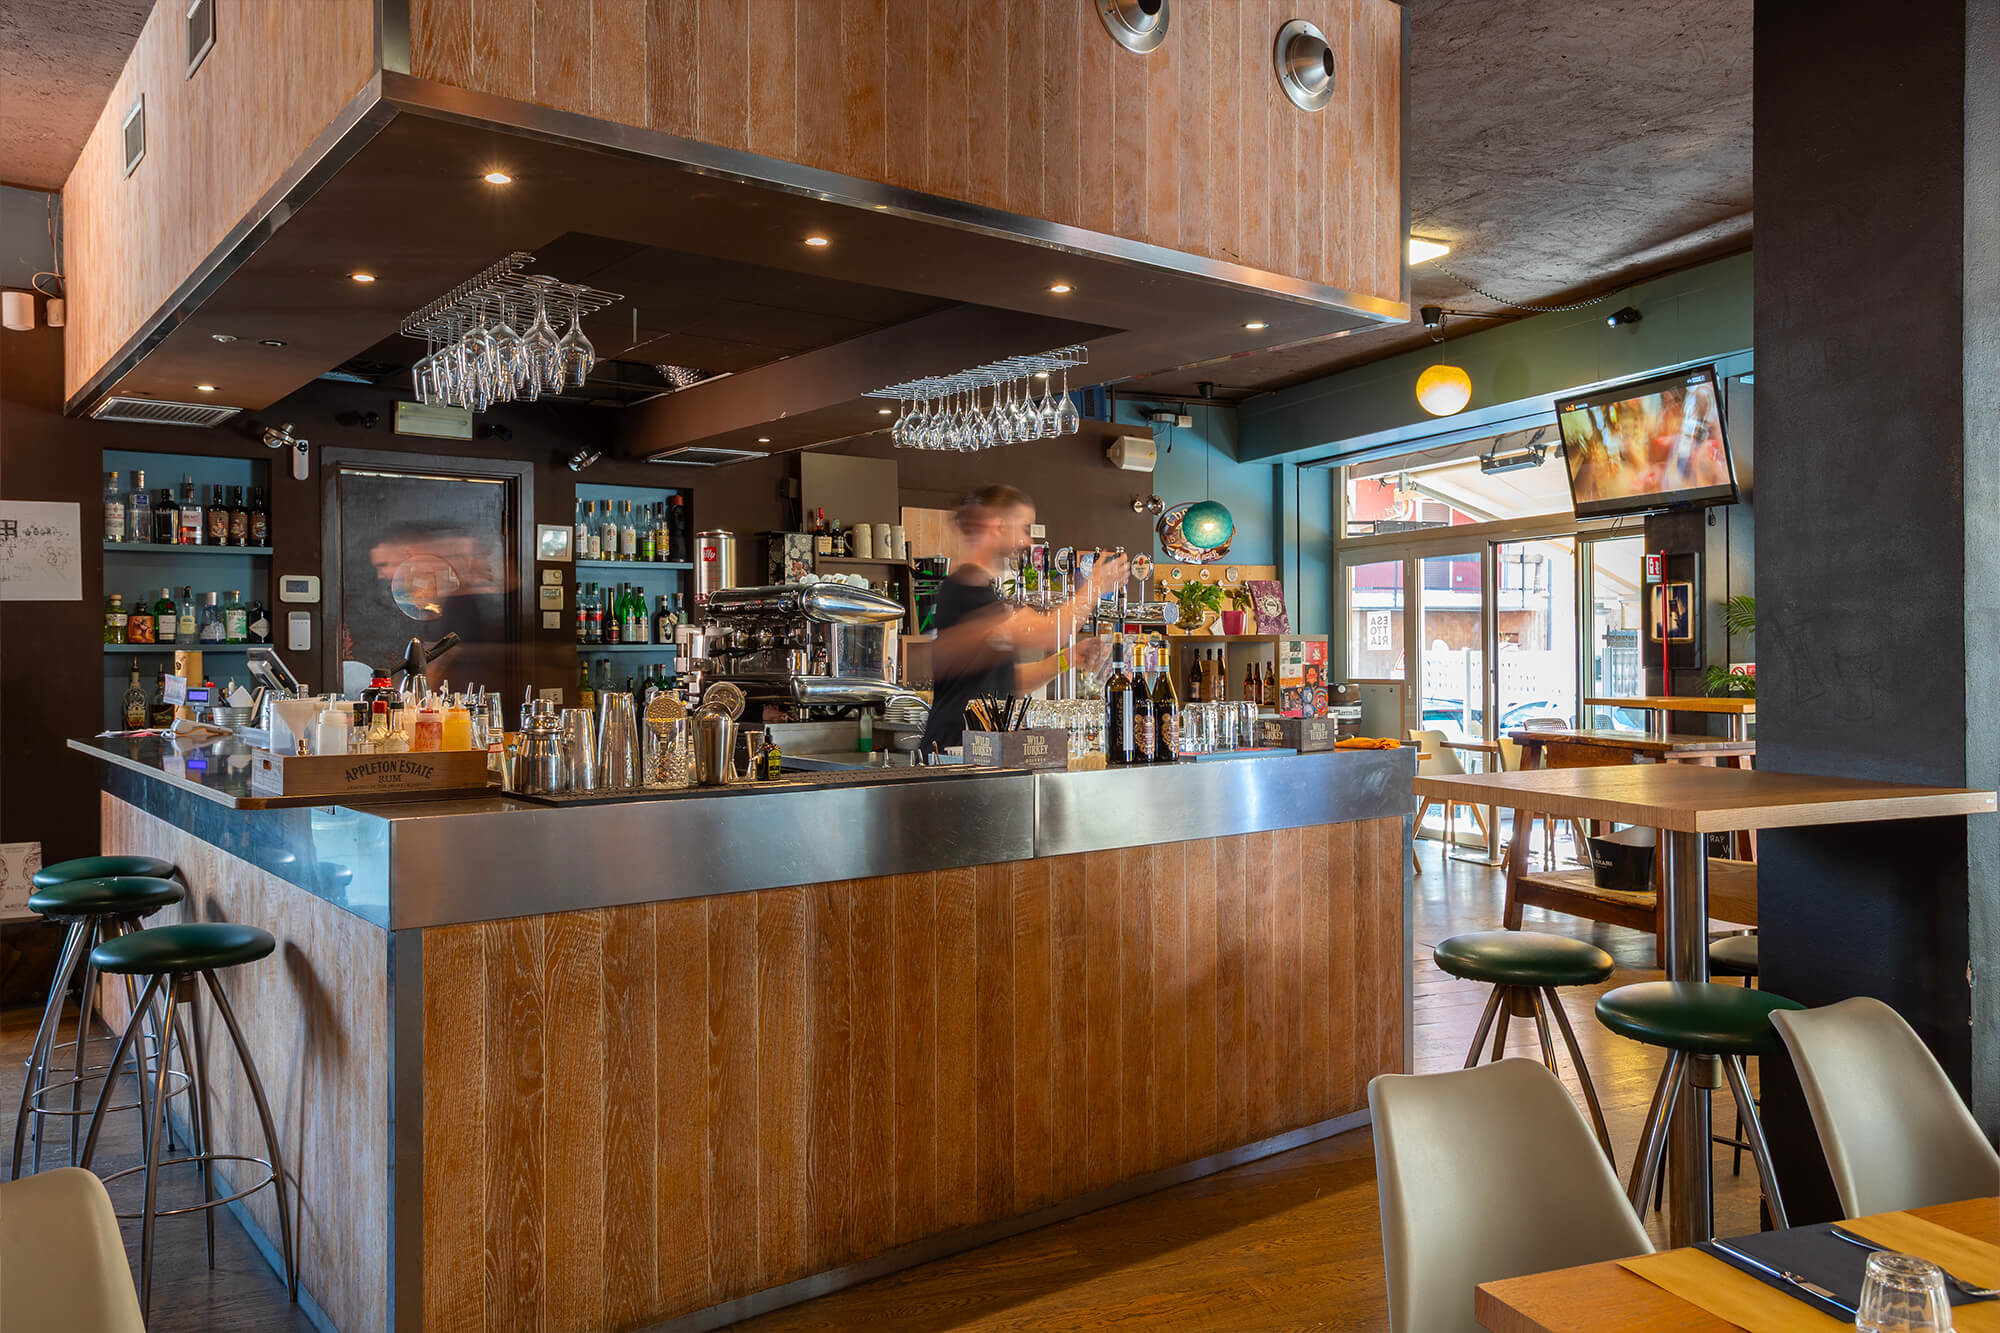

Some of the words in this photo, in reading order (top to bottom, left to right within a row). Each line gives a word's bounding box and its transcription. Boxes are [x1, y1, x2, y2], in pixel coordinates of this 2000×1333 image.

[974, 735, 990, 746] WILD
[1026, 735, 1045, 745] WILD
[972, 743, 992, 756] TURKEY
[1022, 744, 1049, 755] TURKEY
[344, 760, 398, 782] APPLETON
[400, 760, 434, 779] ESTATE
[378, 775, 401, 784] RUM
